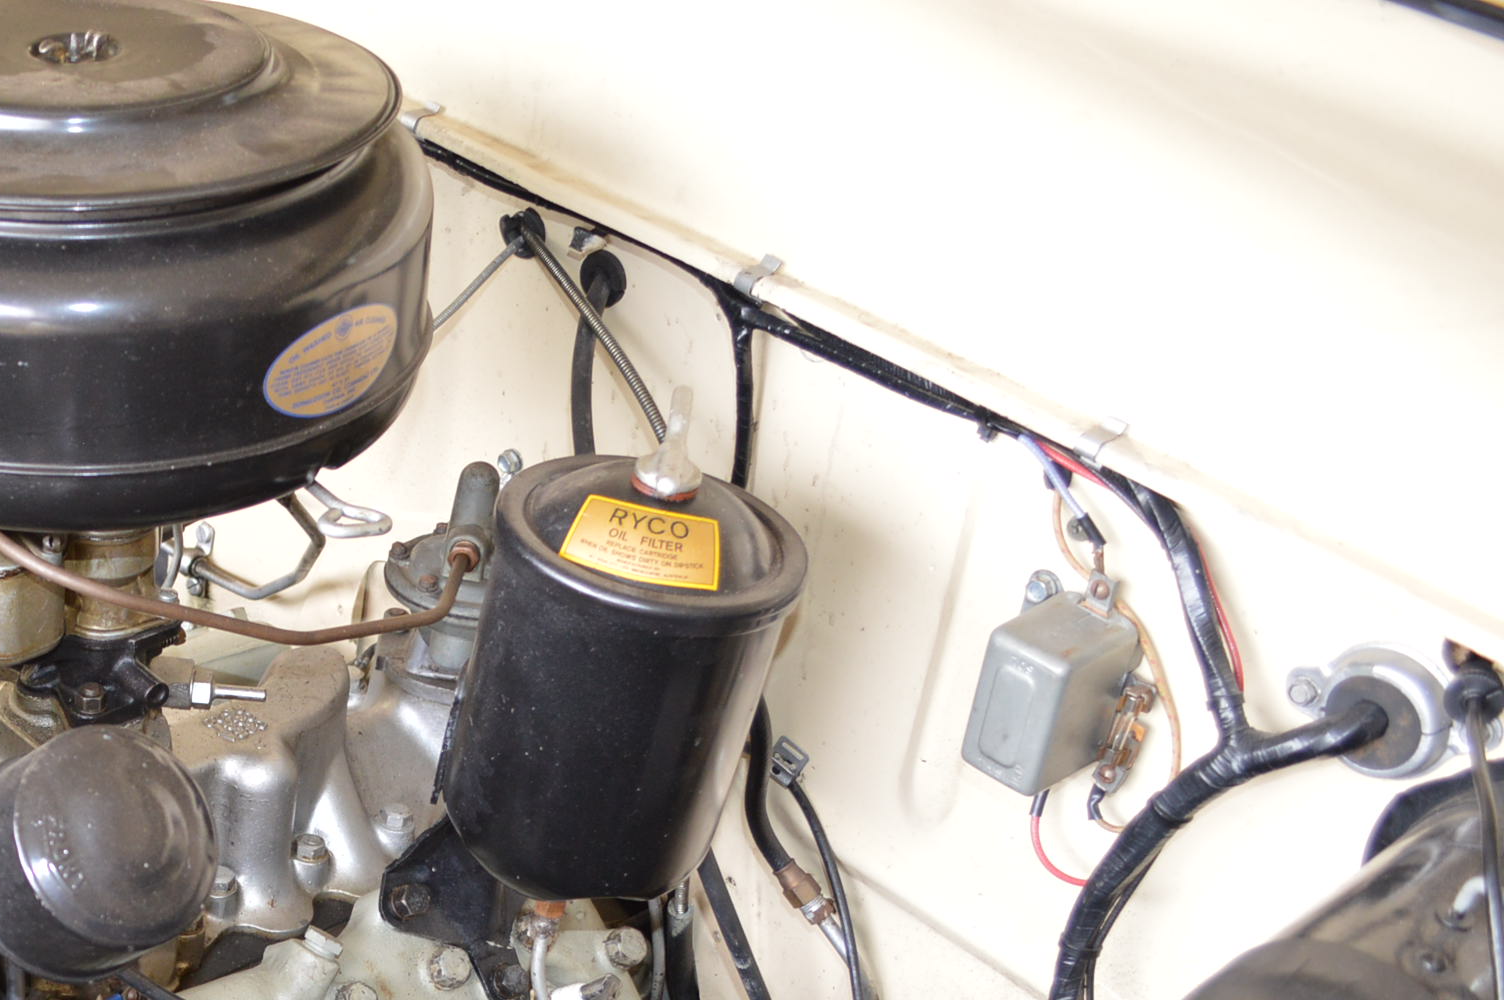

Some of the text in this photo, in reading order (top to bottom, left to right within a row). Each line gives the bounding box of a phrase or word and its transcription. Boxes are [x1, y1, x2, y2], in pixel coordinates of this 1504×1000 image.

[608, 507, 690, 540] RYCO
[606, 540, 678, 560] REPLACE CARTRIDGE
[608, 527, 684, 552] OIL FILTER
